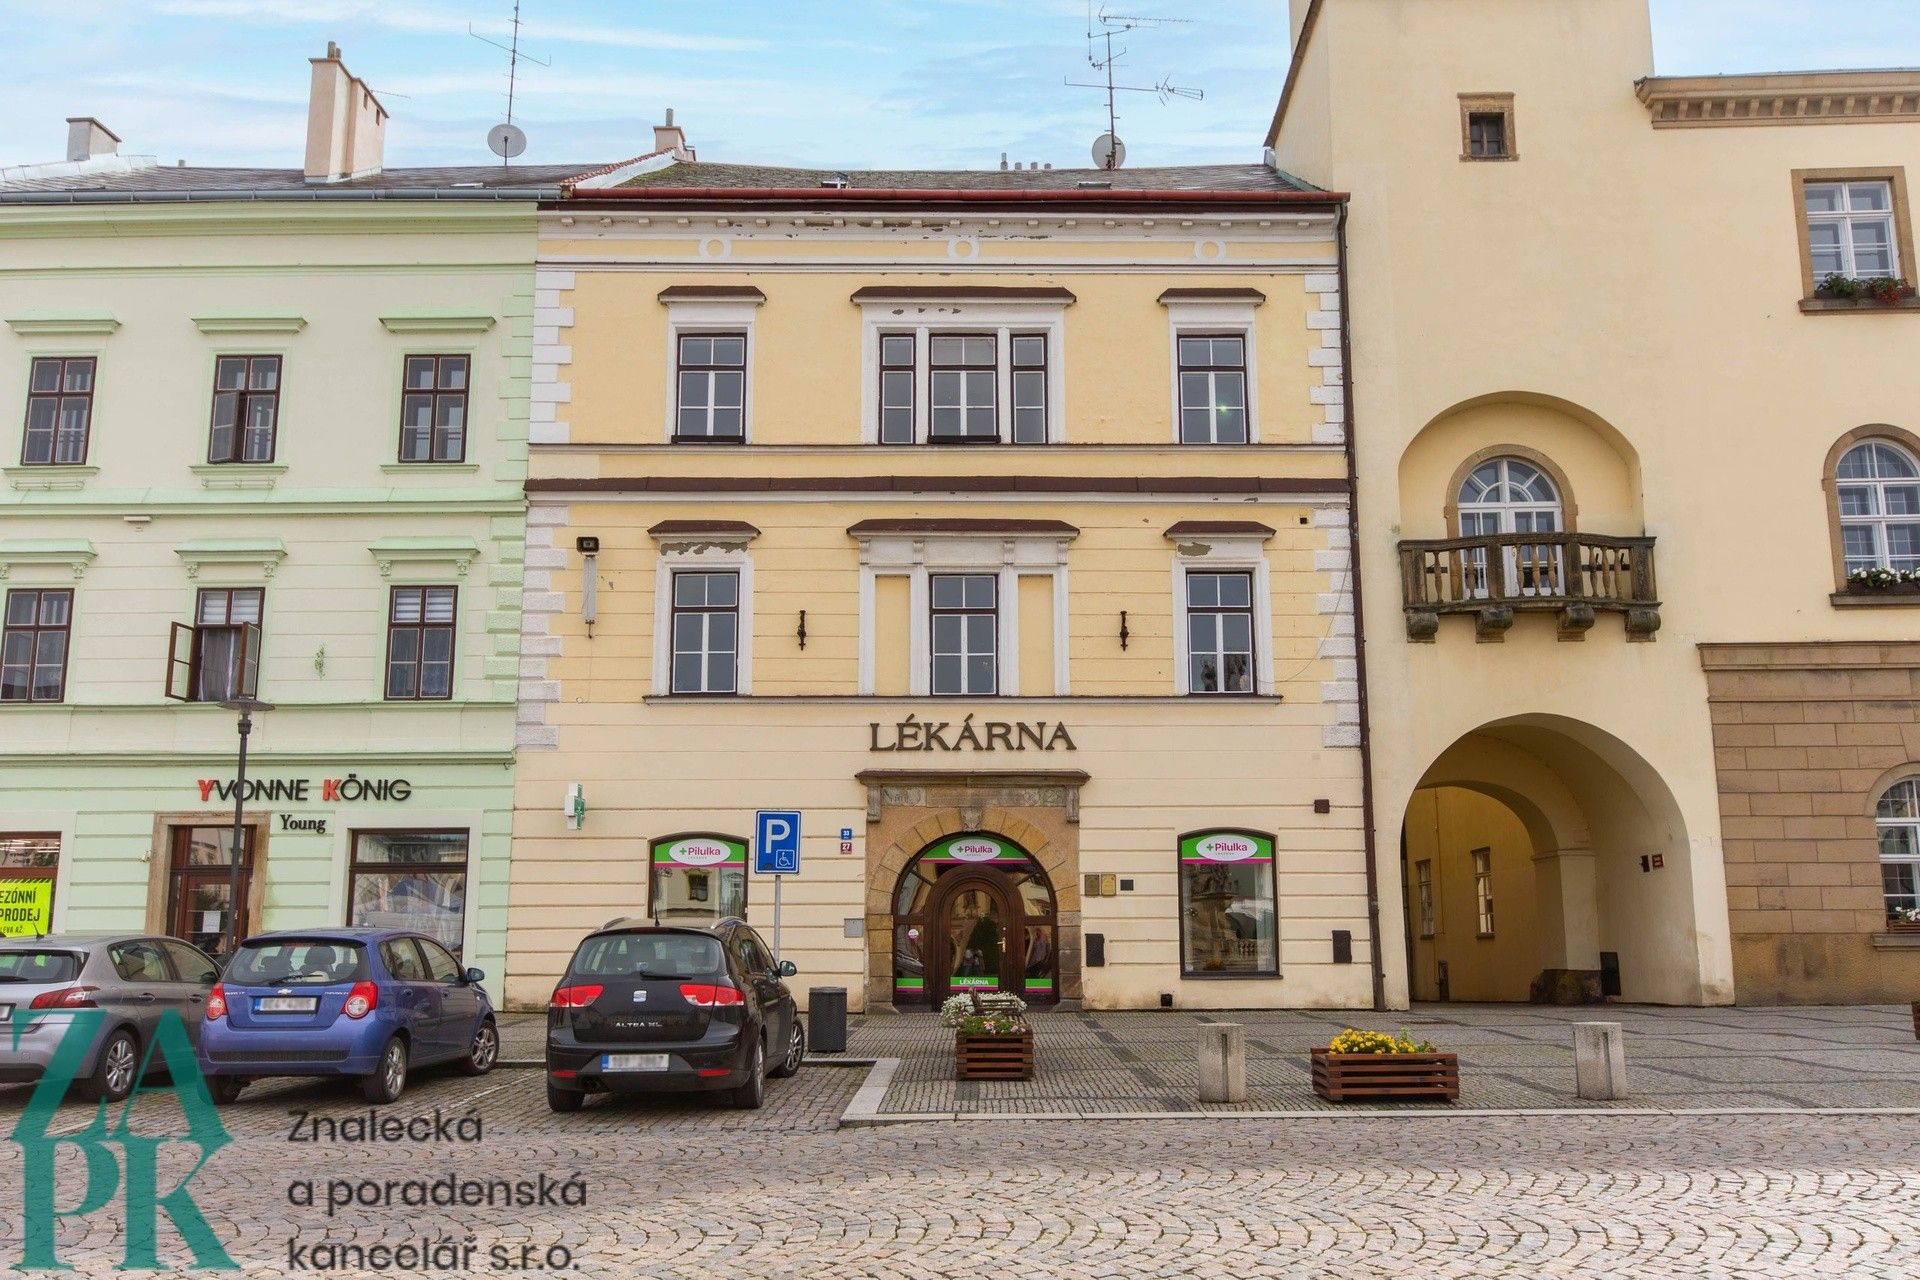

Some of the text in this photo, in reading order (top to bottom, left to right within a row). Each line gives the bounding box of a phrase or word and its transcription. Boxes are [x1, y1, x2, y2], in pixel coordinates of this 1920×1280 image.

[869, 712, 1077, 751] LÉKÁRNA
[198, 773, 412, 802] YVONNE KÖNIG
[280, 814, 326, 834] Young
[765, 819, 790, 854] P
[1215, 842, 1248, 851] Pilulka
[688, 846, 720, 856] Pilulka
[964, 845, 993, 854] Pilulka
